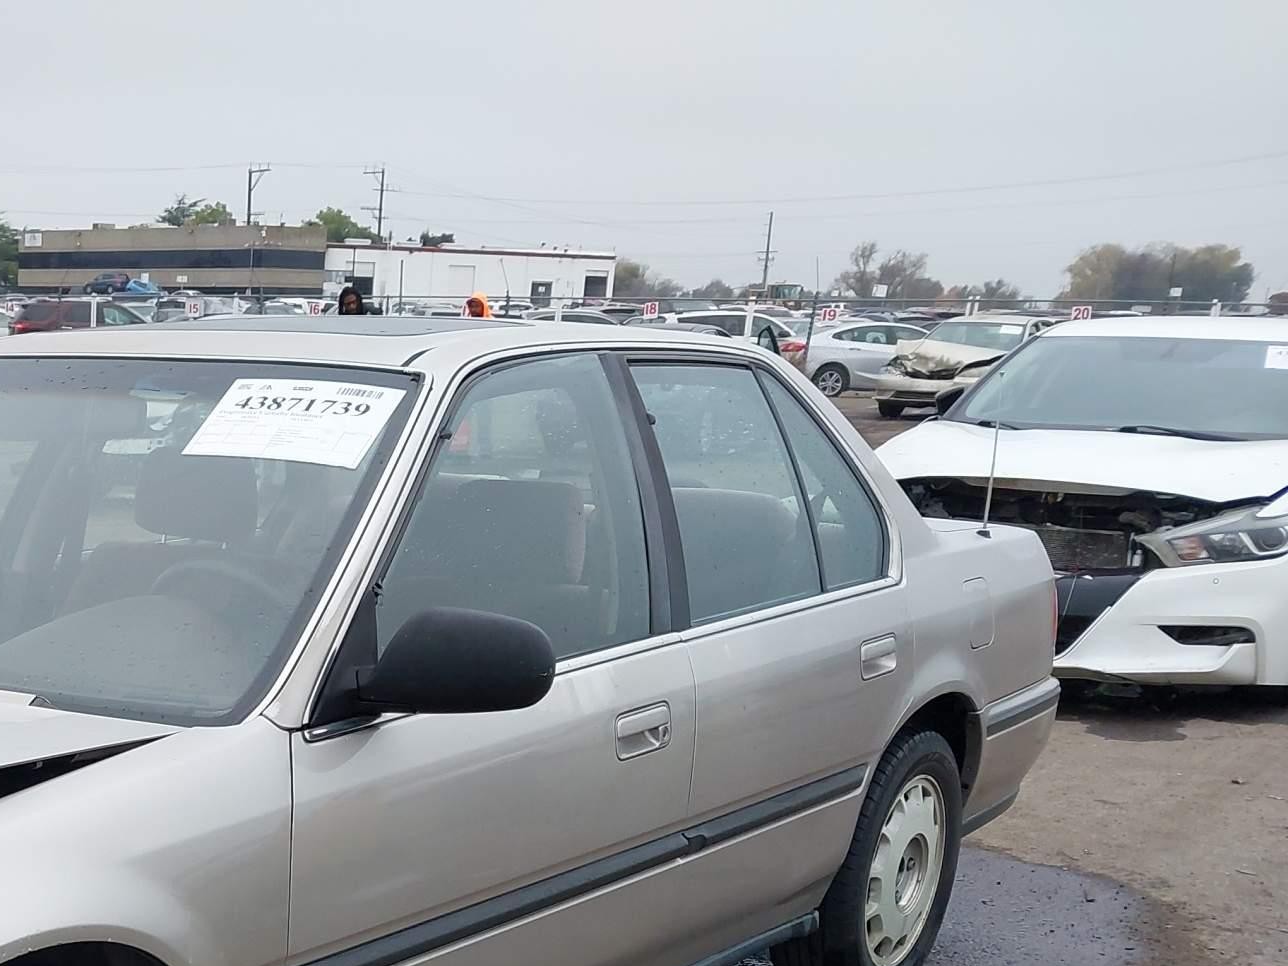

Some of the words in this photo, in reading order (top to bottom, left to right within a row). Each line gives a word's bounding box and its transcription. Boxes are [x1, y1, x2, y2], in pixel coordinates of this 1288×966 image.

[188, 303, 199, 314] 15
[309, 303, 320, 315] 16
[645, 303, 657, 315] 18
[1073, 307, 1090, 320] 20
[822, 309, 836, 322] 19
[234, 395, 371, 417] 43871739
